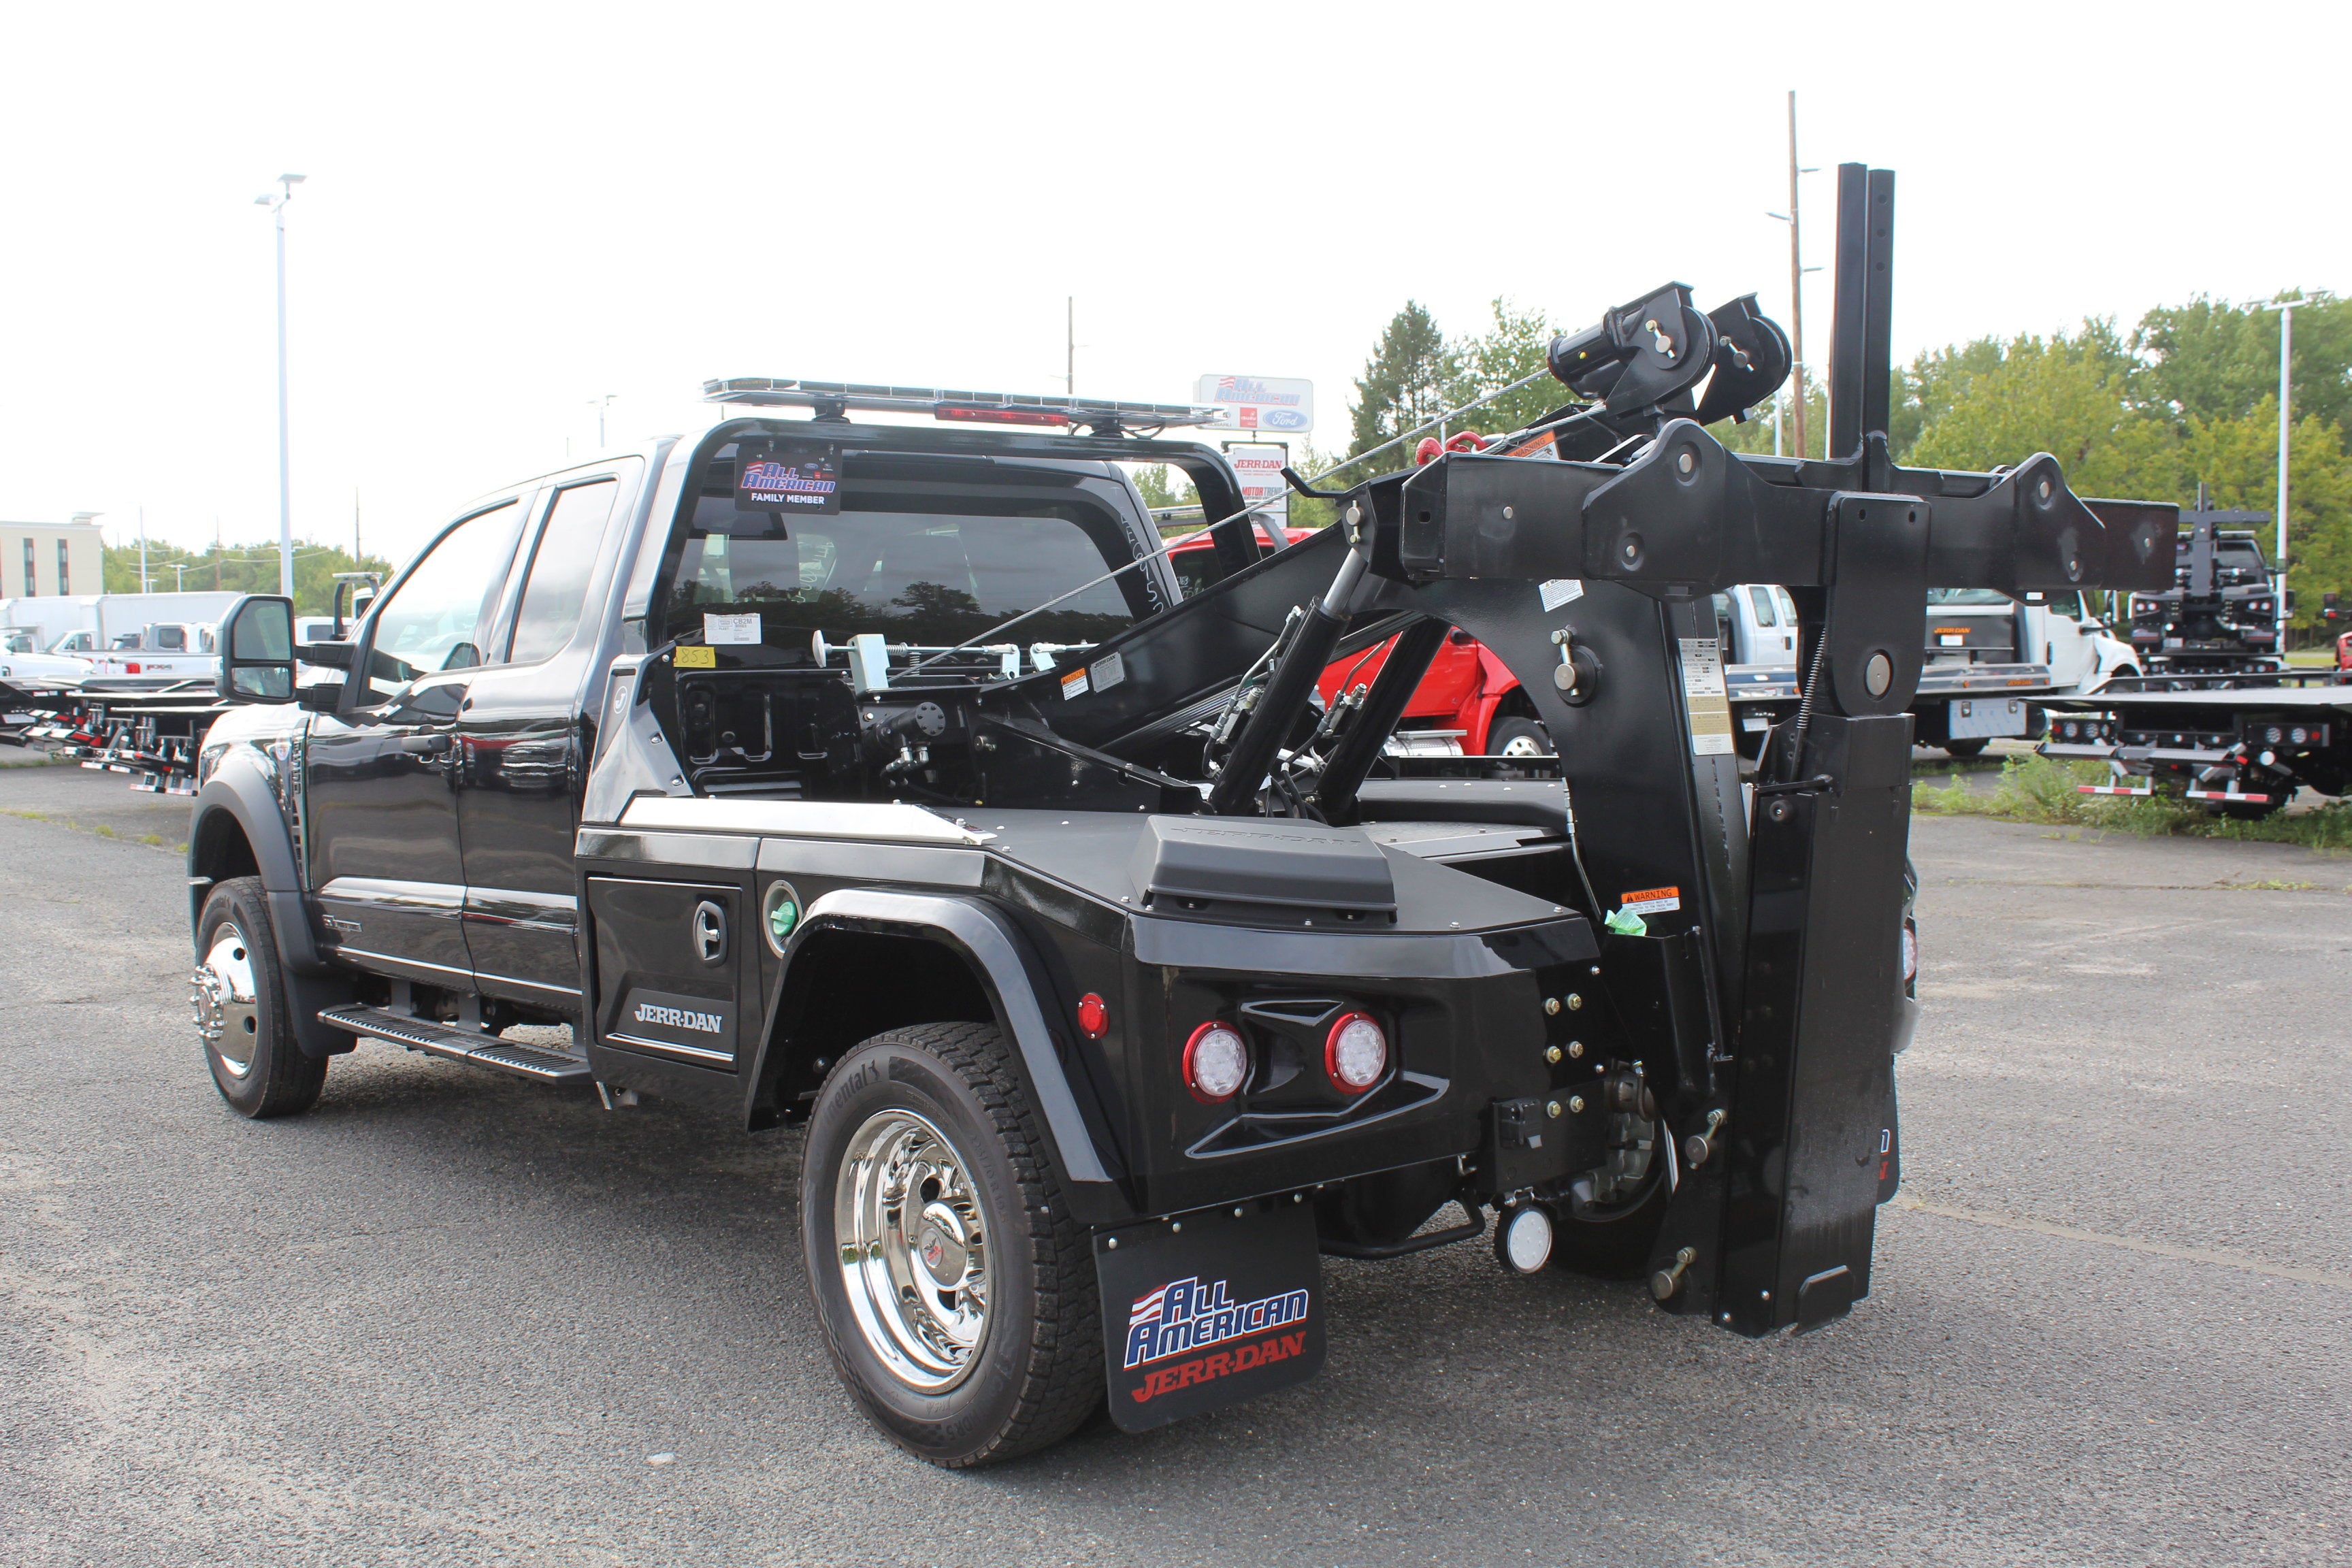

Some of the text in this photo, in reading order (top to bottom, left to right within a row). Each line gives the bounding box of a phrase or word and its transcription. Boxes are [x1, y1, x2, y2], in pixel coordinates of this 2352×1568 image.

[1214, 386, 1301, 406] AMERICAN
[1272, 411, 1298, 425] Ford
[761, 462, 799, 479] ALL
[740, 472, 836, 493] AMERICAN
[751, 492, 825, 505] FAMILY MEMBER
[1634, 889, 1672, 901] WARNING
[1161, 1276, 1235, 1327] ALL
[1123, 1288, 1309, 1371] AMERICAN
